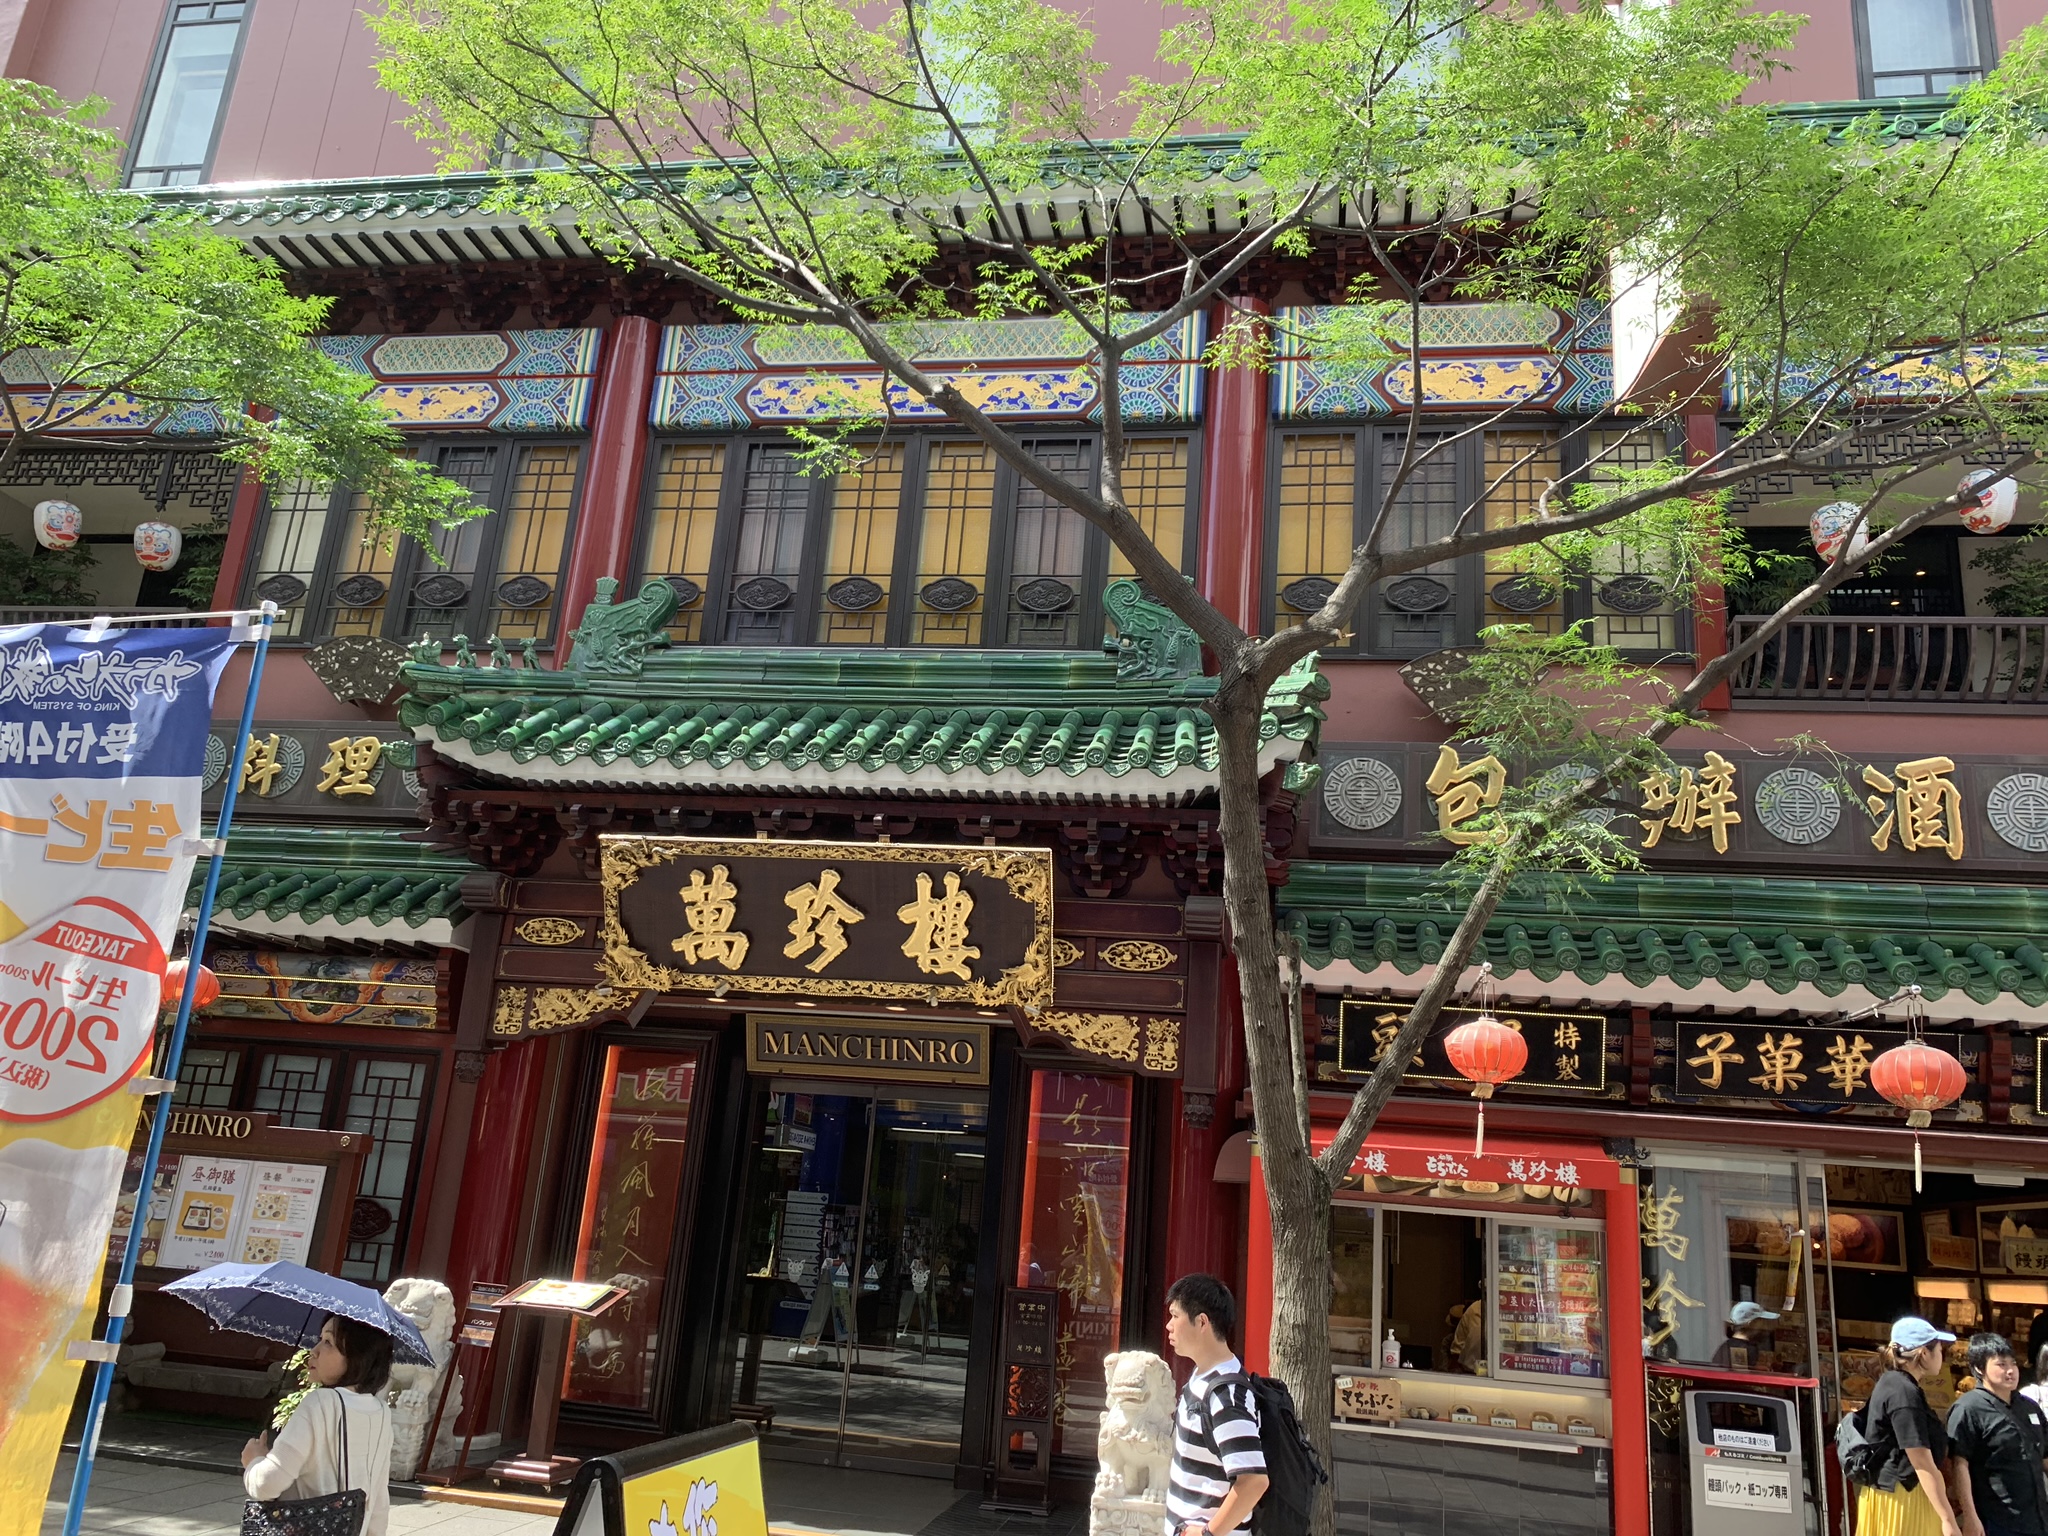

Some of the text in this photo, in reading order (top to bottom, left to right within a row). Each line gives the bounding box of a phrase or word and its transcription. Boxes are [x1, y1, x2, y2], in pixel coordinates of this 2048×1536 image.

[672, 863, 982, 981] 萬珍樓
[763, 1031, 974, 1065] MANCHINRO
[1554, 1021, 1582, 1081] 特製
[191, 1166, 236, 1185] 昼御膳
[1426, 1158, 1469, 1178] もちぶた
[1506, 1157, 1581, 1186] 萬珍樓
[1708, 1477, 1788, 1499] 饅頭パック・紙コップ専用
